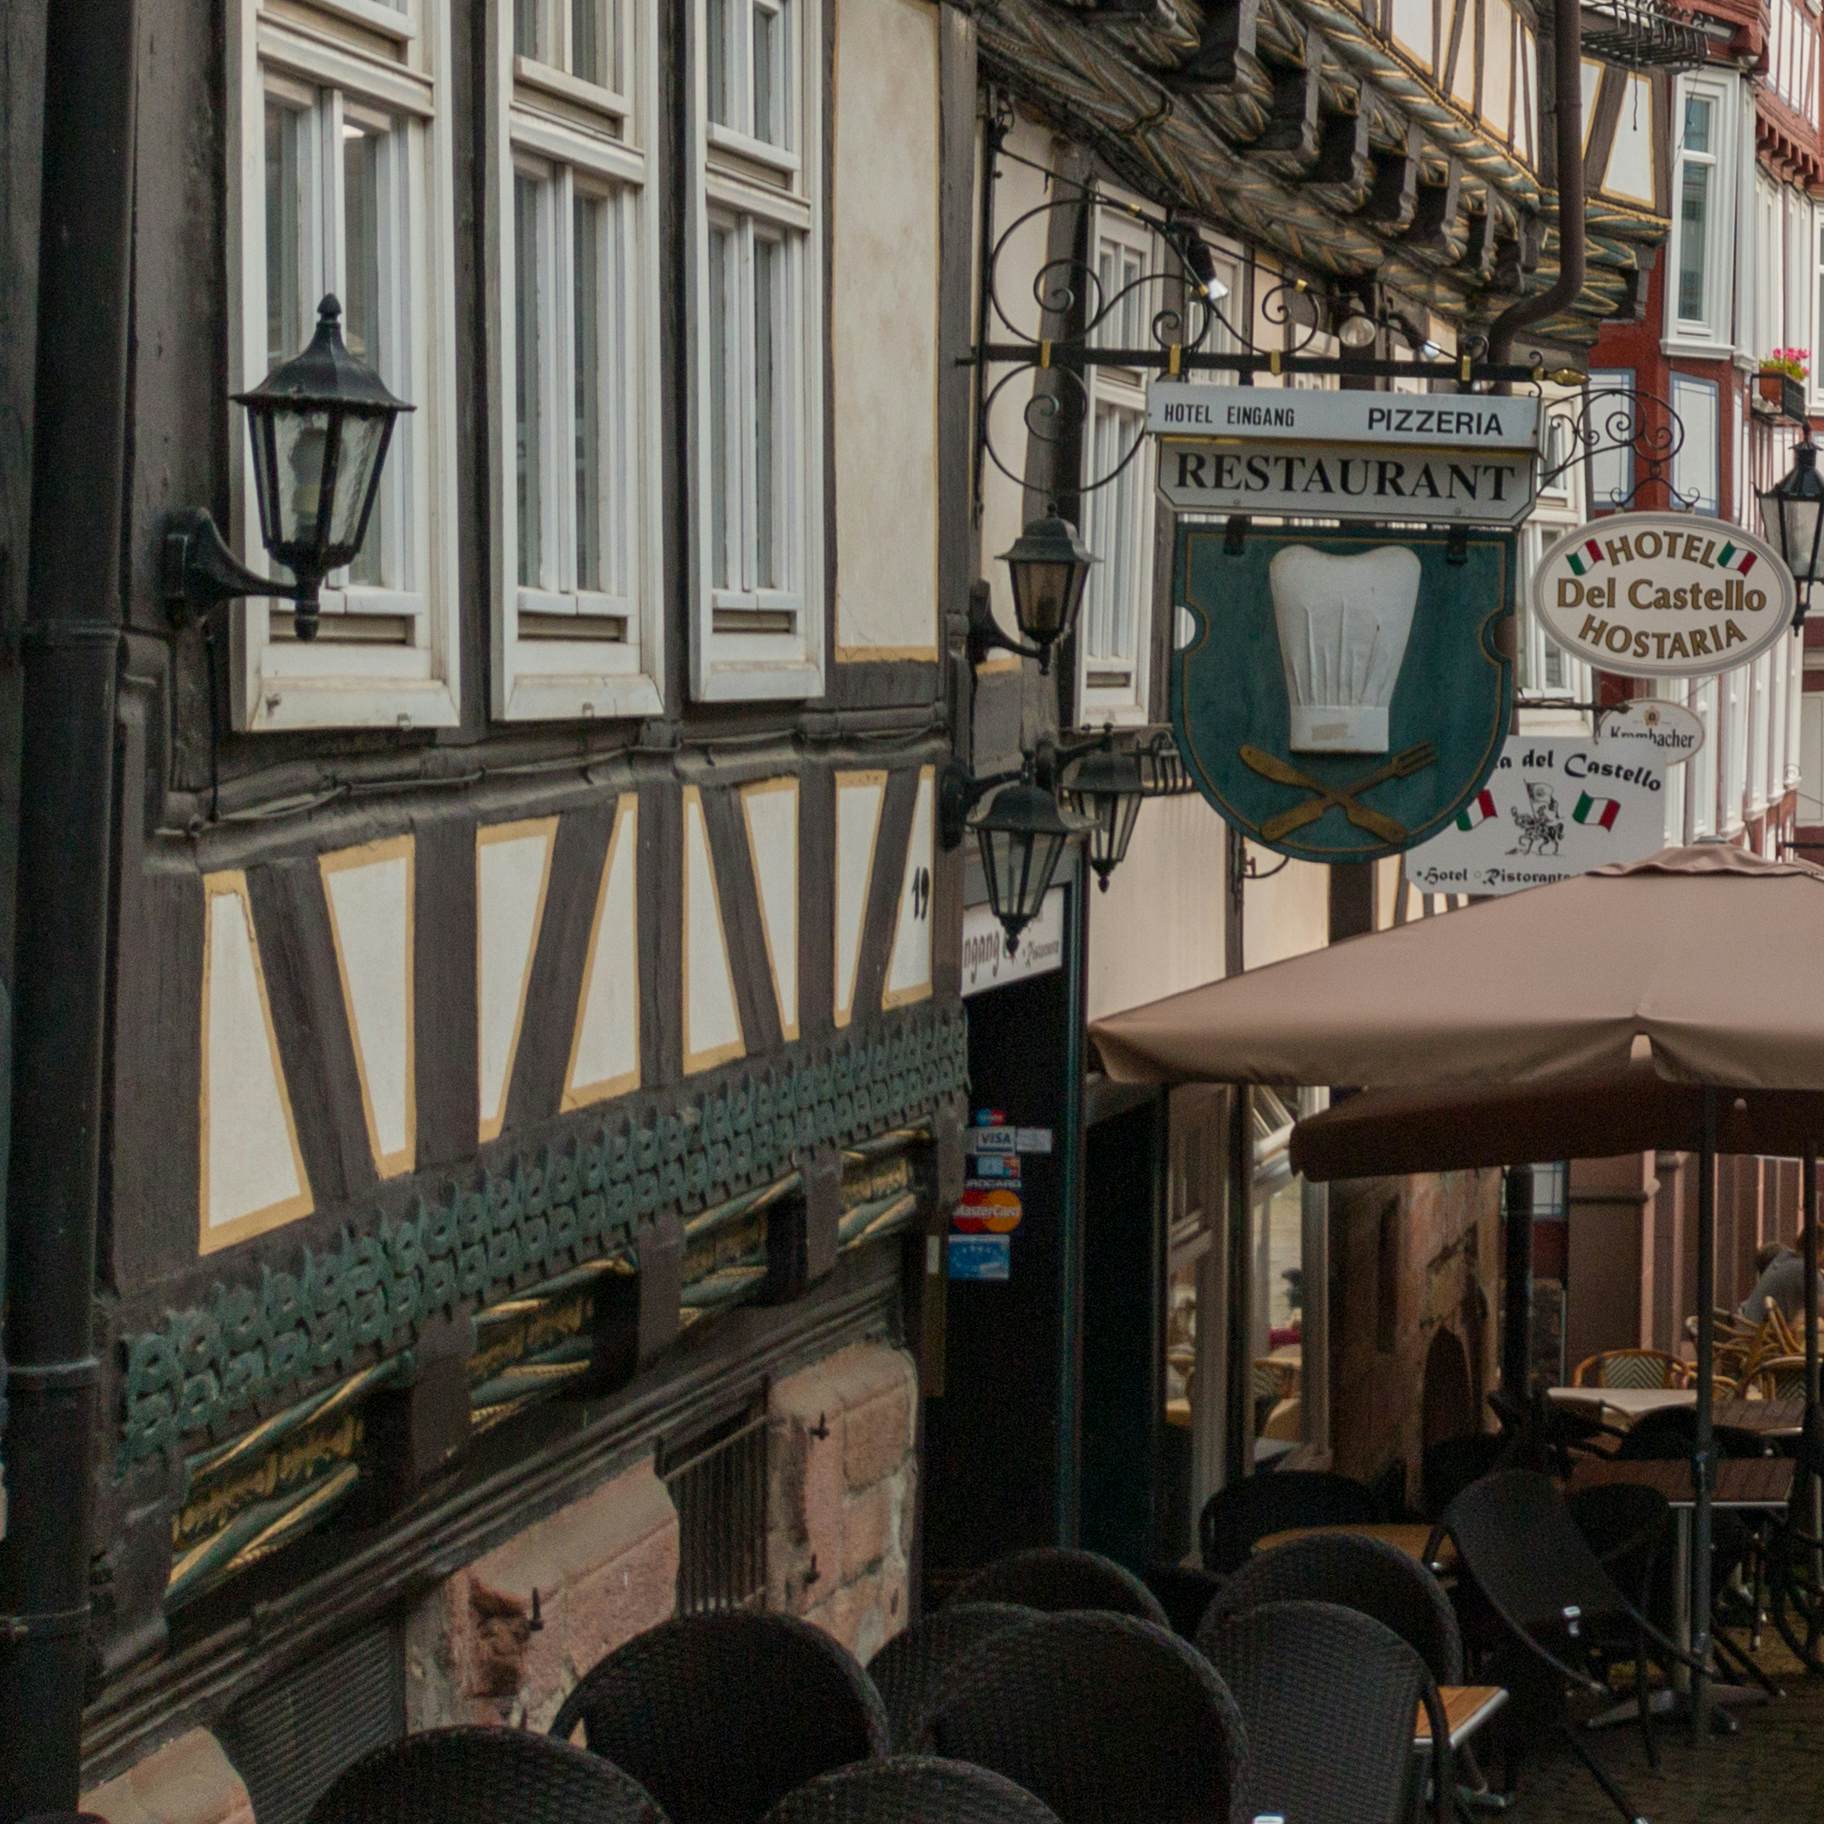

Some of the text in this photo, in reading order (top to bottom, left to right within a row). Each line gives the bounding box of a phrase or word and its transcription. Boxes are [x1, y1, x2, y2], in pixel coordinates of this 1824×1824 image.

[1164, 403, 1295, 428] HOTEL EINGANG
[1367, 407, 1504, 437] PIZZERIA
[1175, 451, 1515, 502] RESTAURANT
[1605, 530, 1716, 569] HOTEL
[1557, 577, 1767, 612] Del Castello
[1578, 614, 1748, 660] HOSTARIA
[1522, 749, 1554, 769] del
[1564, 753, 1662, 792] Castello
[911, 864, 930, 922] 19
[1424, 866, 1468, 885] Hotel
[964, 930, 1000, 984] ngang
[981, 1132, 1011, 1144] VISA
